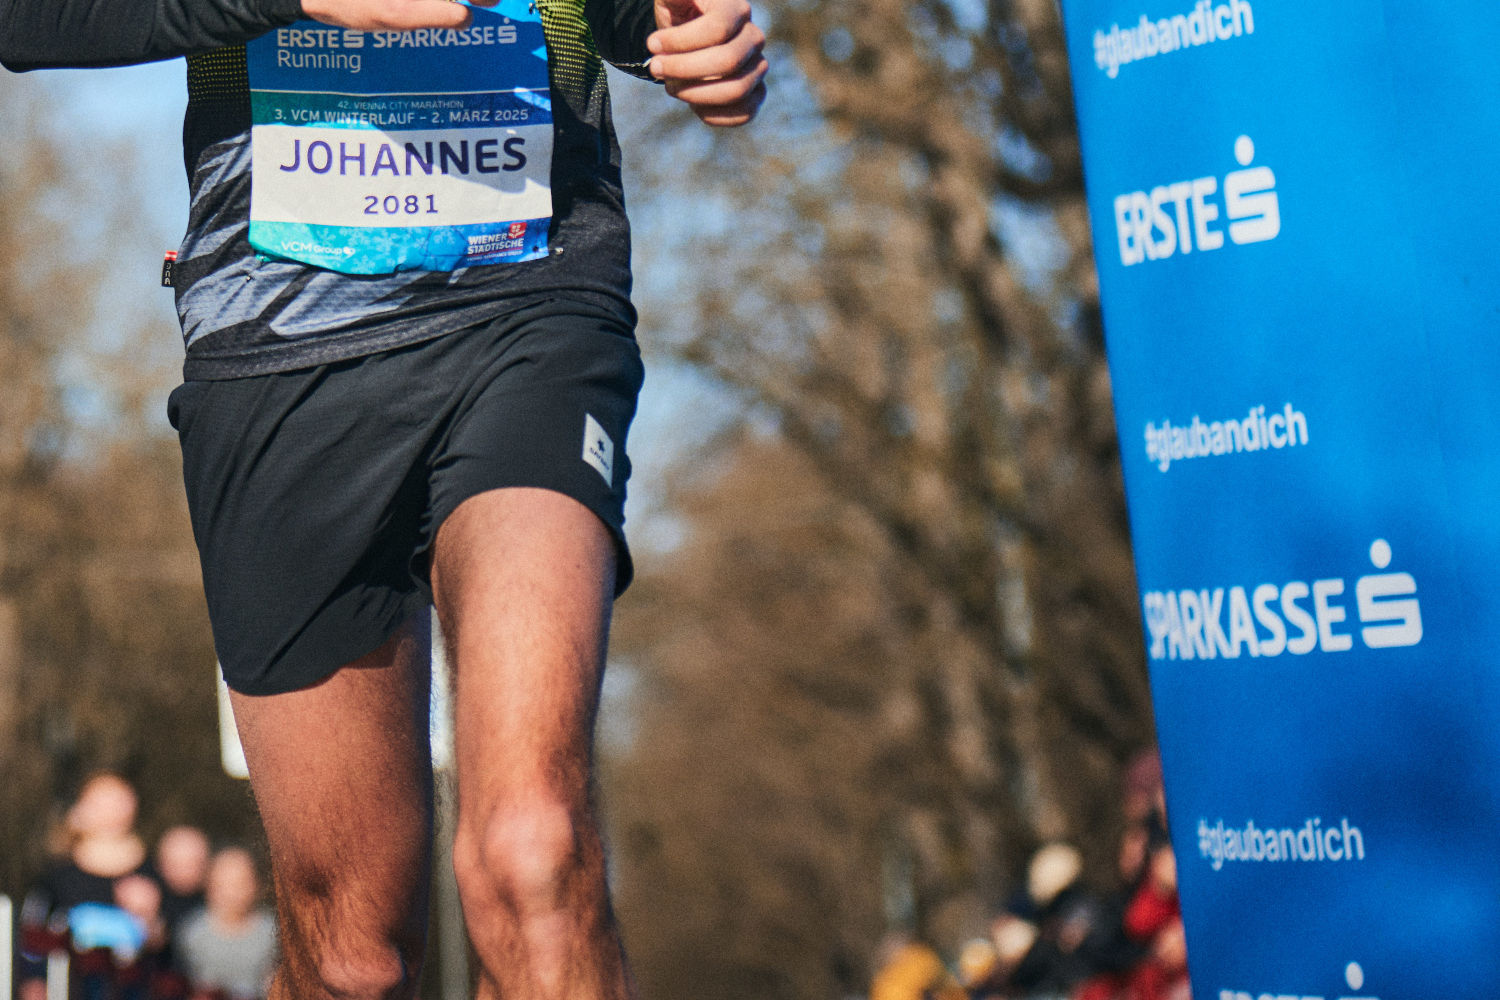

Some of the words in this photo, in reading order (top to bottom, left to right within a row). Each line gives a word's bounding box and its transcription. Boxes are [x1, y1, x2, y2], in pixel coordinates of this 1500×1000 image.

[277, 29, 339, 48] ERSTE
[373, 26, 494, 48] SPARKASSE
[277, 50, 361, 73] Running
[354, 102, 387, 110] VIENNA
[389, 102, 409, 110] CITY
[411, 100, 464, 109] MARATHON
[274, 109, 287, 120] 3.
[291, 109, 320, 121] VCM
[324, 111, 415, 125] WINTERLAUF
[432, 112, 444, 123] 2.
[450, 109, 490, 123] MÄRZ
[494, 109, 529, 121] 2025
[279, 137, 528, 177] JOHANNES
[363, 194, 439, 214] 2081
[1114, 176, 1224, 266] ERSTE
[281, 241, 312, 252] VCM
[313, 245, 342, 255] Group
[467, 233, 507, 245] WIENER
[1145, 403, 1309, 472] #glaubandich
[1143, 578, 1353, 660] SPARKASSE
[1198, 817, 1364, 871] #glaubandich
